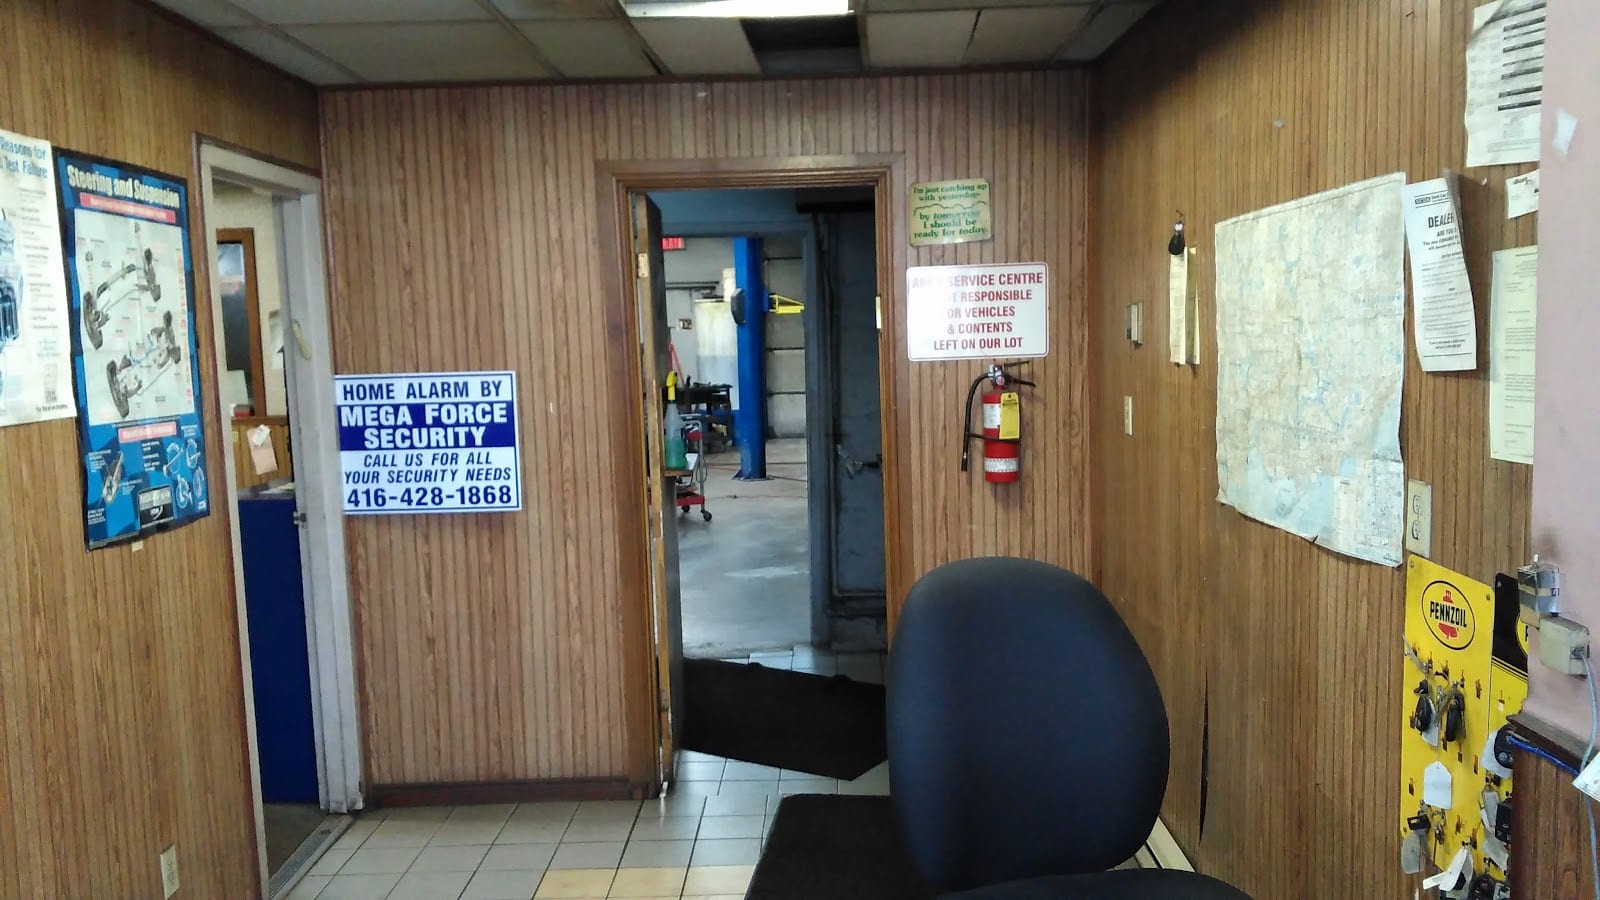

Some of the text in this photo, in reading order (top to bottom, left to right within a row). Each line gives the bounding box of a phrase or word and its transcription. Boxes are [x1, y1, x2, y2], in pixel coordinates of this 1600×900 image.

[67, 164, 113, 196] Steering
[114, 178, 133, 198] and
[134, 179, 180, 208] Suspension
[925, 187, 939, 195] just
[941, 184, 975, 192] catching
[930, 219, 961, 228] should
[914, 229, 939, 238] ready
[942, 228, 956, 236] for
[949, 274, 995, 287] SERVICE
[998, 272, 1043, 286] CENTRE
[960, 289, 1032, 303] RESPONSIBLE
[965, 306, 1015, 318] VEHICLES
[947, 322, 1013, 335] & CONTENTS
[933, 337, 1024, 351] LEFT ON OUR LOT
[343, 380, 502, 400] HOME ALARM BY
[340, 403, 507, 427] MEGA FORCE
[364, 426, 486, 449] SECURITY
[363, 452, 492, 468] CALL US FOR ALL
[344, 467, 512, 485] YOUR SECURITY NEEDS
[347, 485, 512, 507] 416-428-1868
[1430, 601, 1467, 628] PENNZOIL
